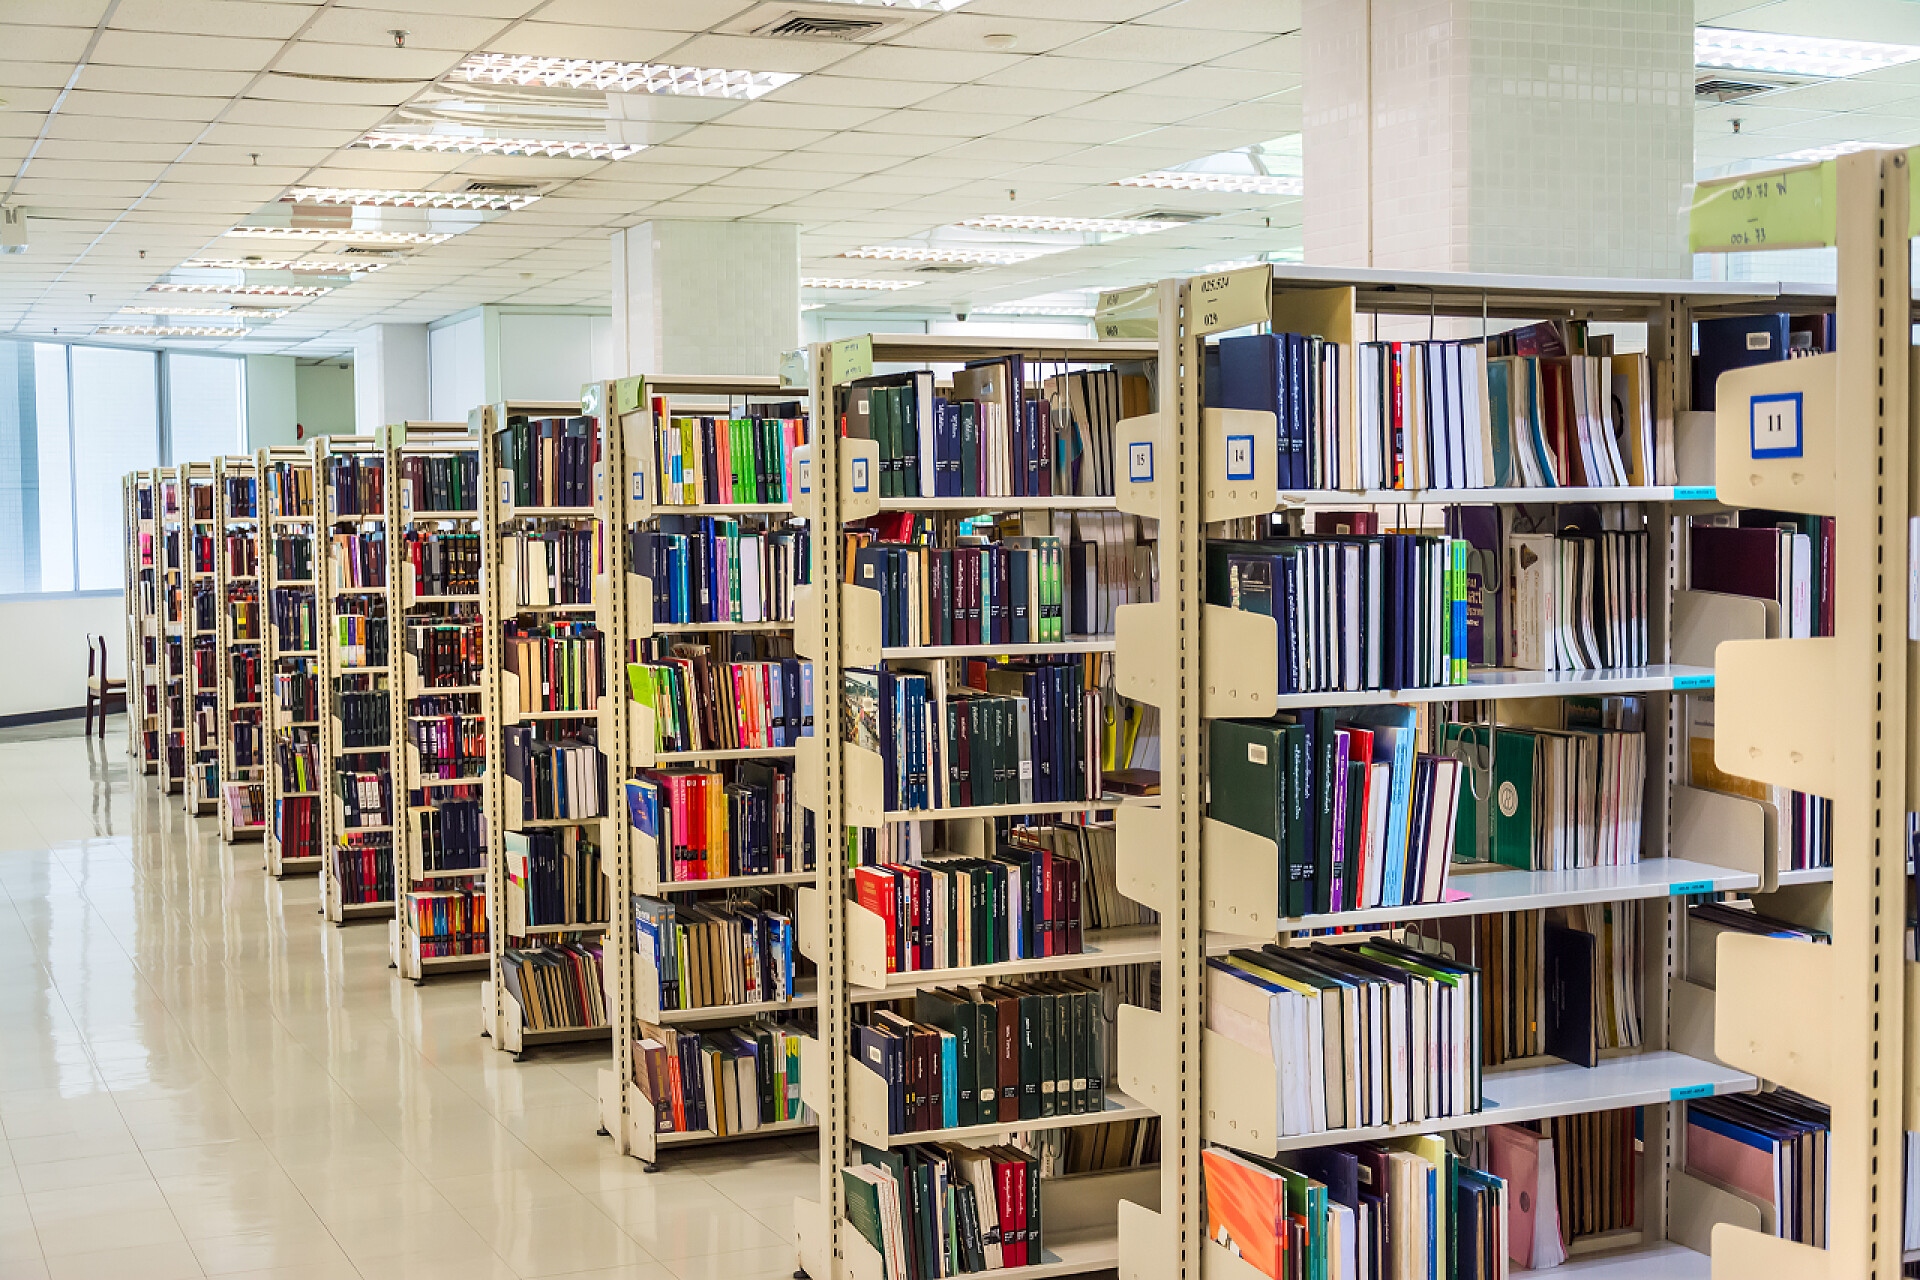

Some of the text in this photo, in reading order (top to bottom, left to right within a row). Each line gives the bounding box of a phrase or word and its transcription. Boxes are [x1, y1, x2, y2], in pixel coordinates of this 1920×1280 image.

[1768, 413, 1782, 432] 11
[1136, 453, 1146, 466] 15
[1235, 449, 1245, 462] 14
